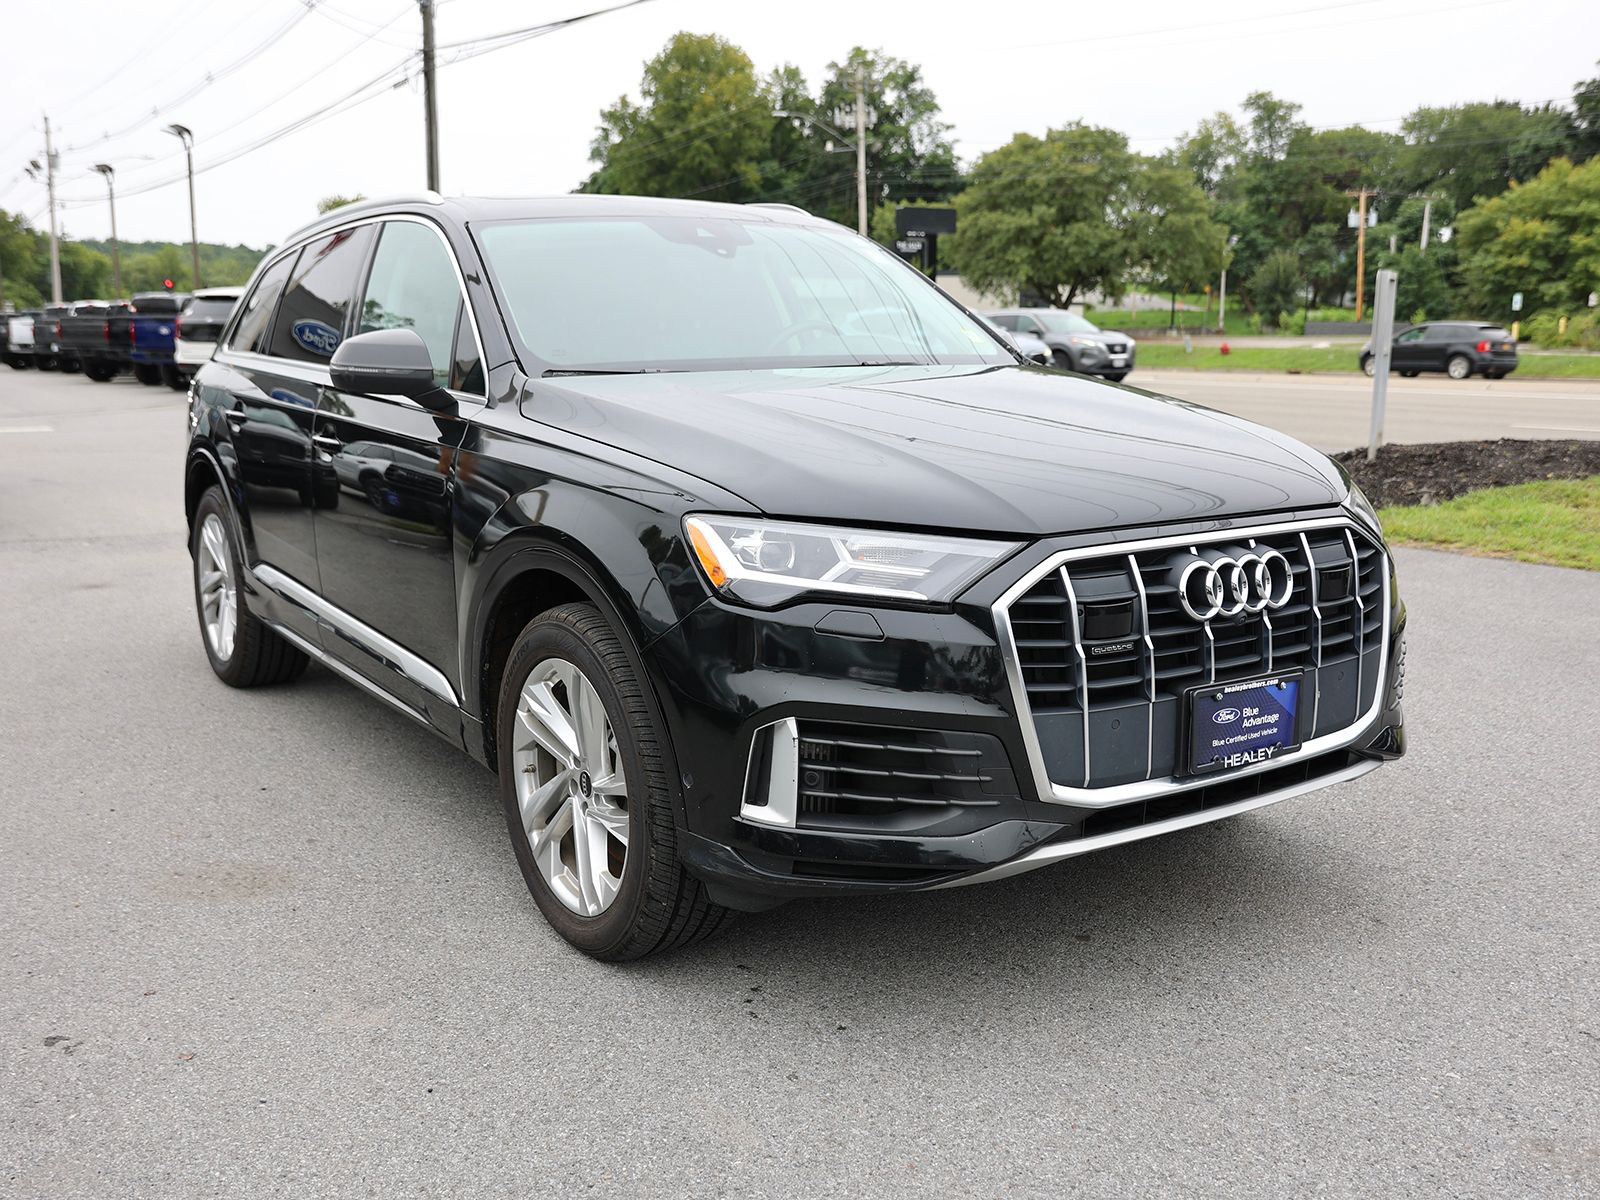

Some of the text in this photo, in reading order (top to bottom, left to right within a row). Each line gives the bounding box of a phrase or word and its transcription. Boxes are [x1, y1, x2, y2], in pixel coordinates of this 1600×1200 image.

[1094, 643, 1133, 653] quattro
[1224, 679, 1279, 693] healeybrothers.com
[1242, 707, 1259, 717] Blue
[1242, 713, 1280, 728] Advantage
[1225, 734, 1248, 745] Certified
[1247, 731, 1261, 740] Used
[1261, 727, 1278, 736] Vehicle
[1224, 746, 1275, 768] HEALEY
